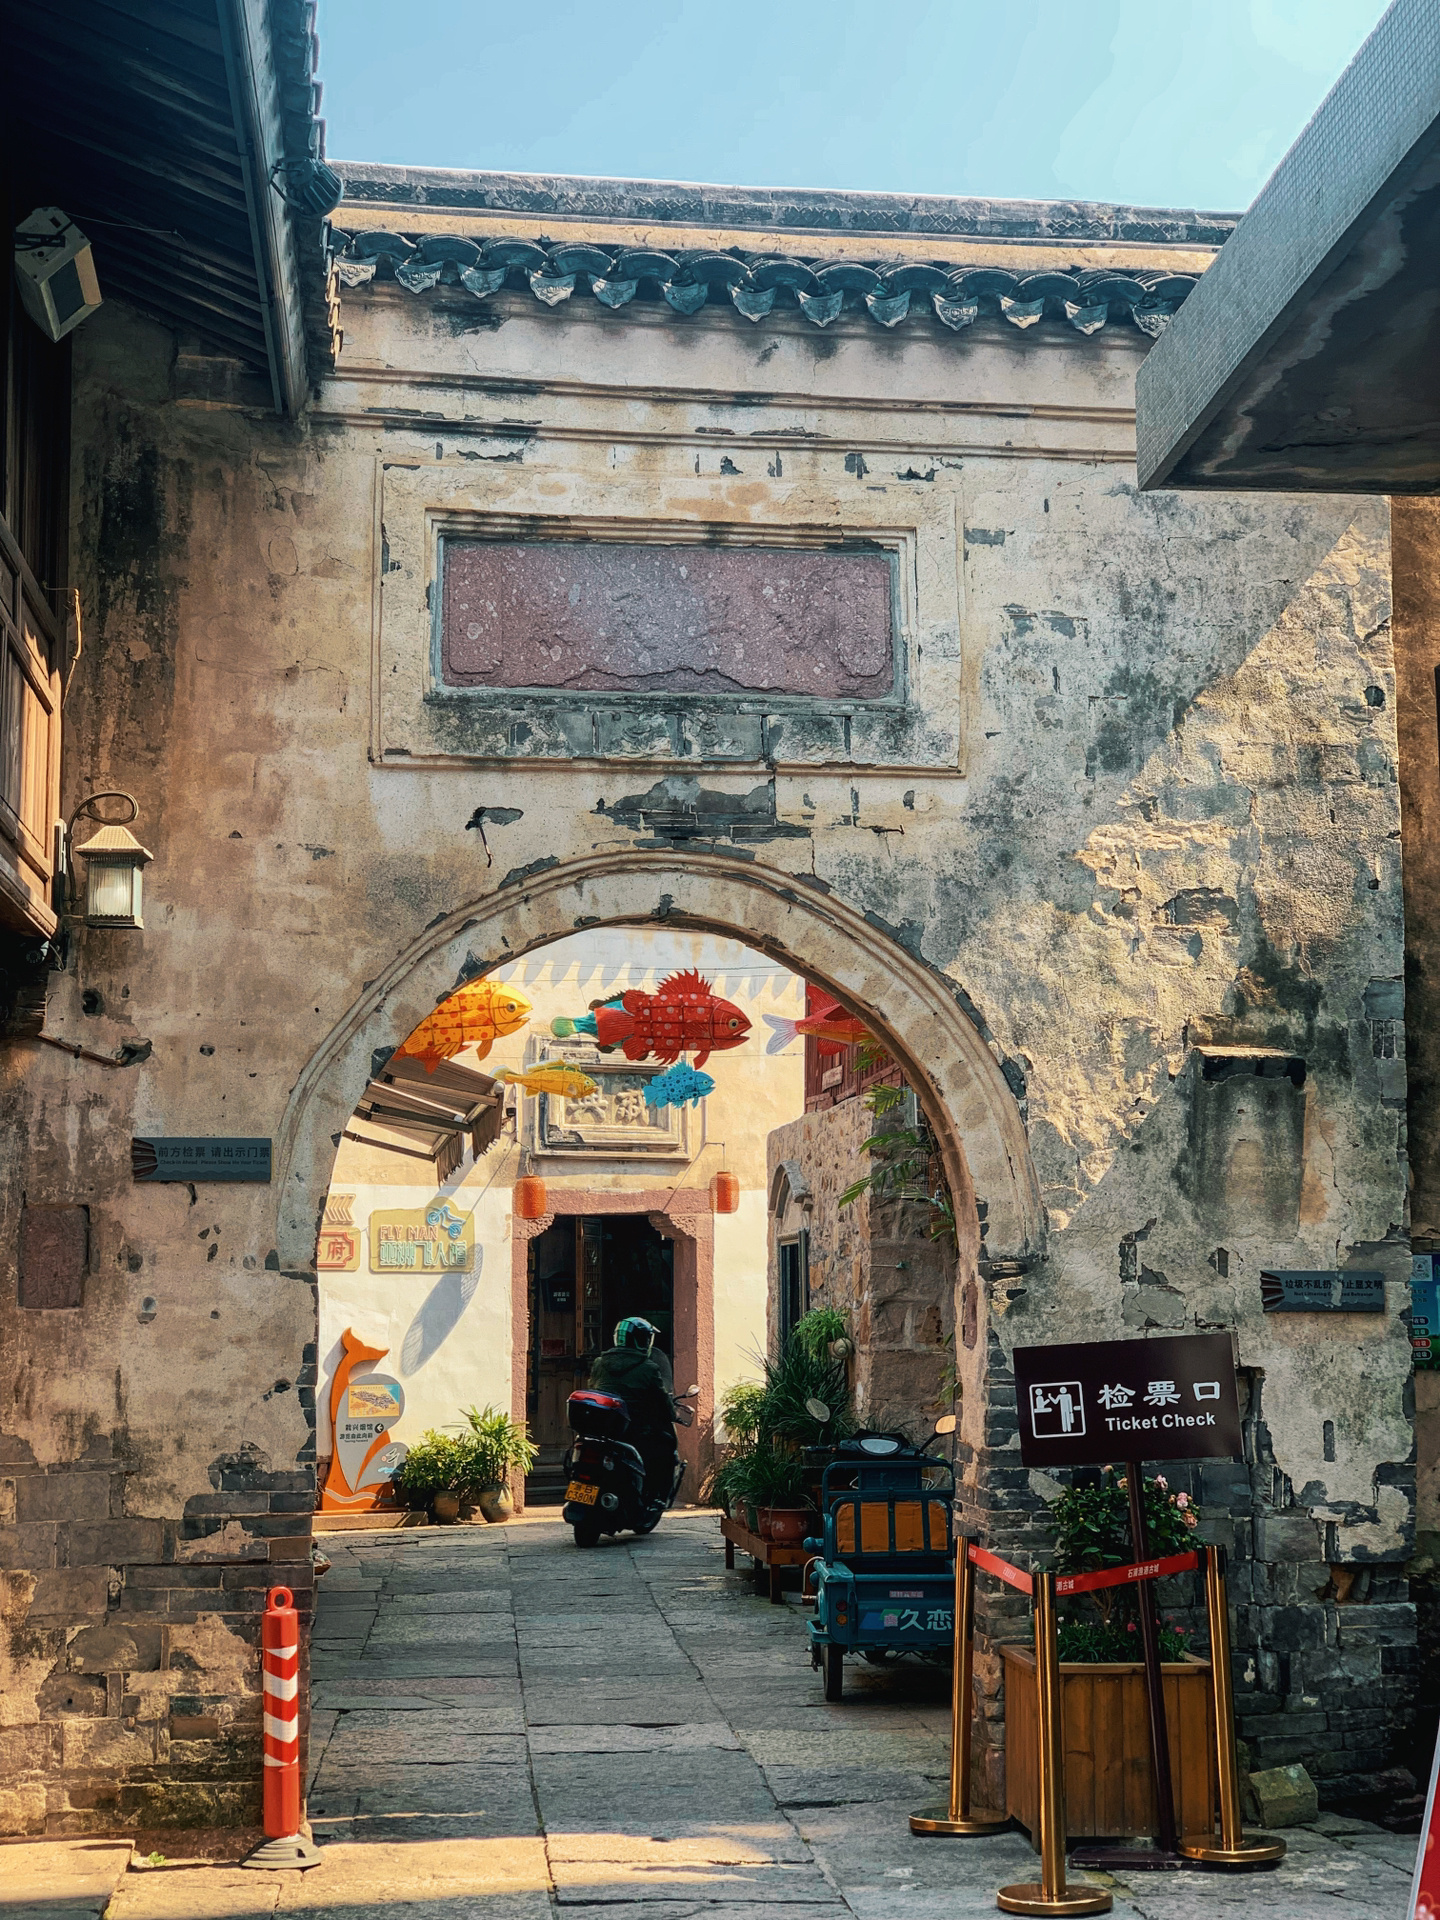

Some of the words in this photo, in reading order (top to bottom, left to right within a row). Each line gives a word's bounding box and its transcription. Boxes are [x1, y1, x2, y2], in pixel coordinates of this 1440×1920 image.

[158, 1146, 206, 1158] 前方检票
[211, 1146, 270, 1158] 请出示门票
[380, 1224, 403, 1240] FLY
[408, 1224, 438, 1240] MAN
[1285, 1279, 1332, 1289] 垃圾不乱扔
[1097, 1381, 1220, 1410] 检票口
[1105, 1415, 1158, 1431] Ticket
[1162, 1412, 1216, 1428] Check
